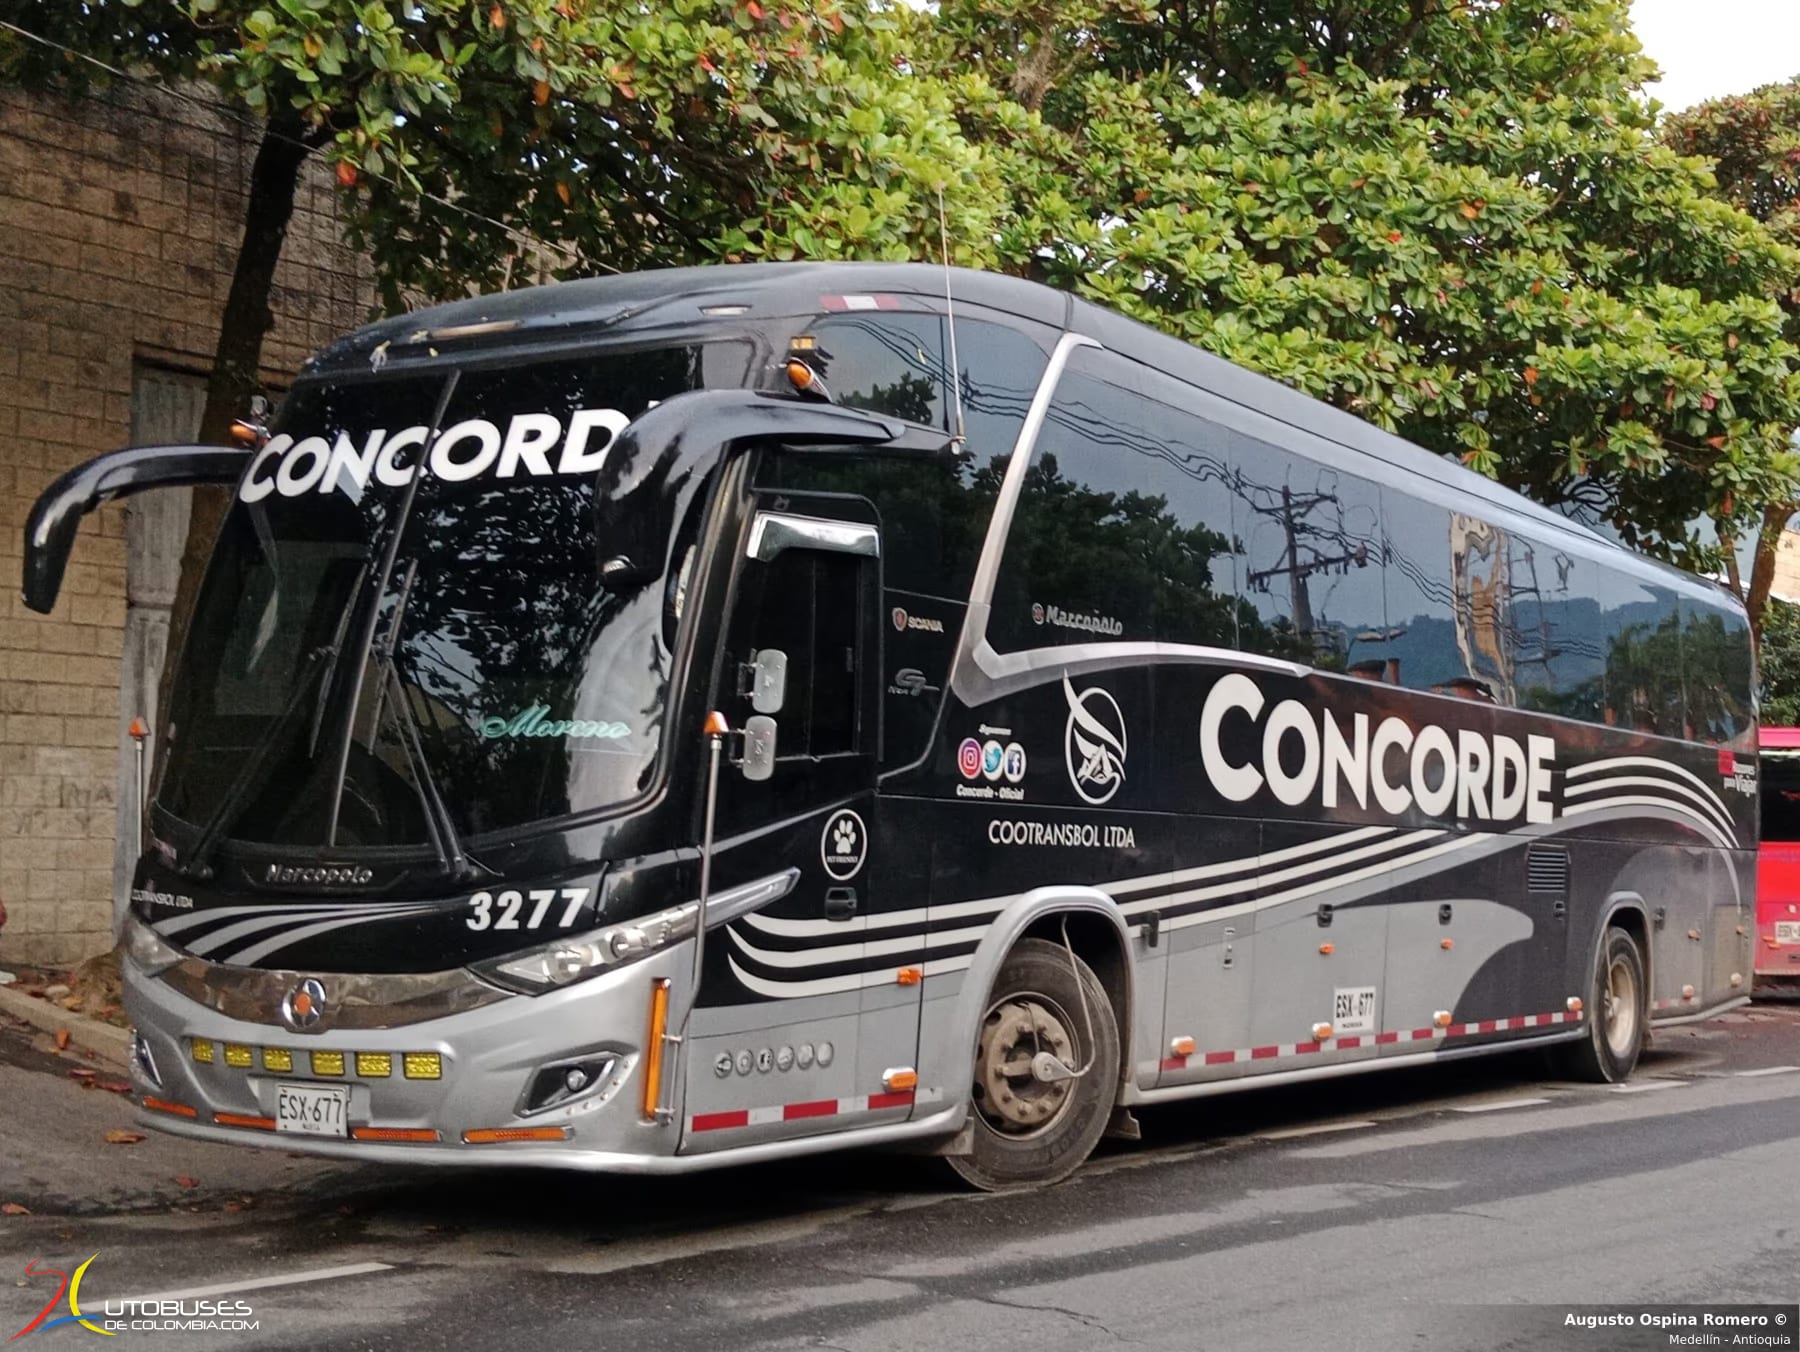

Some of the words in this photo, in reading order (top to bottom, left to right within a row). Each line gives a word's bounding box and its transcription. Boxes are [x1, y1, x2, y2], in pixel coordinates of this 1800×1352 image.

[239, 401, 660, 504] CONCORD
[908, 616, 944, 633] SCANIA
[1046, 605, 1123, 636] Marcopolo
[1200, 673, 1556, 824] CONCORDE
[988, 819, 1100, 847] COOTRANSBOL
[1103, 825, 1136, 849] LTDA
[266, 864, 374, 885] Marcopolo
[465, 887, 591, 931] 3277
